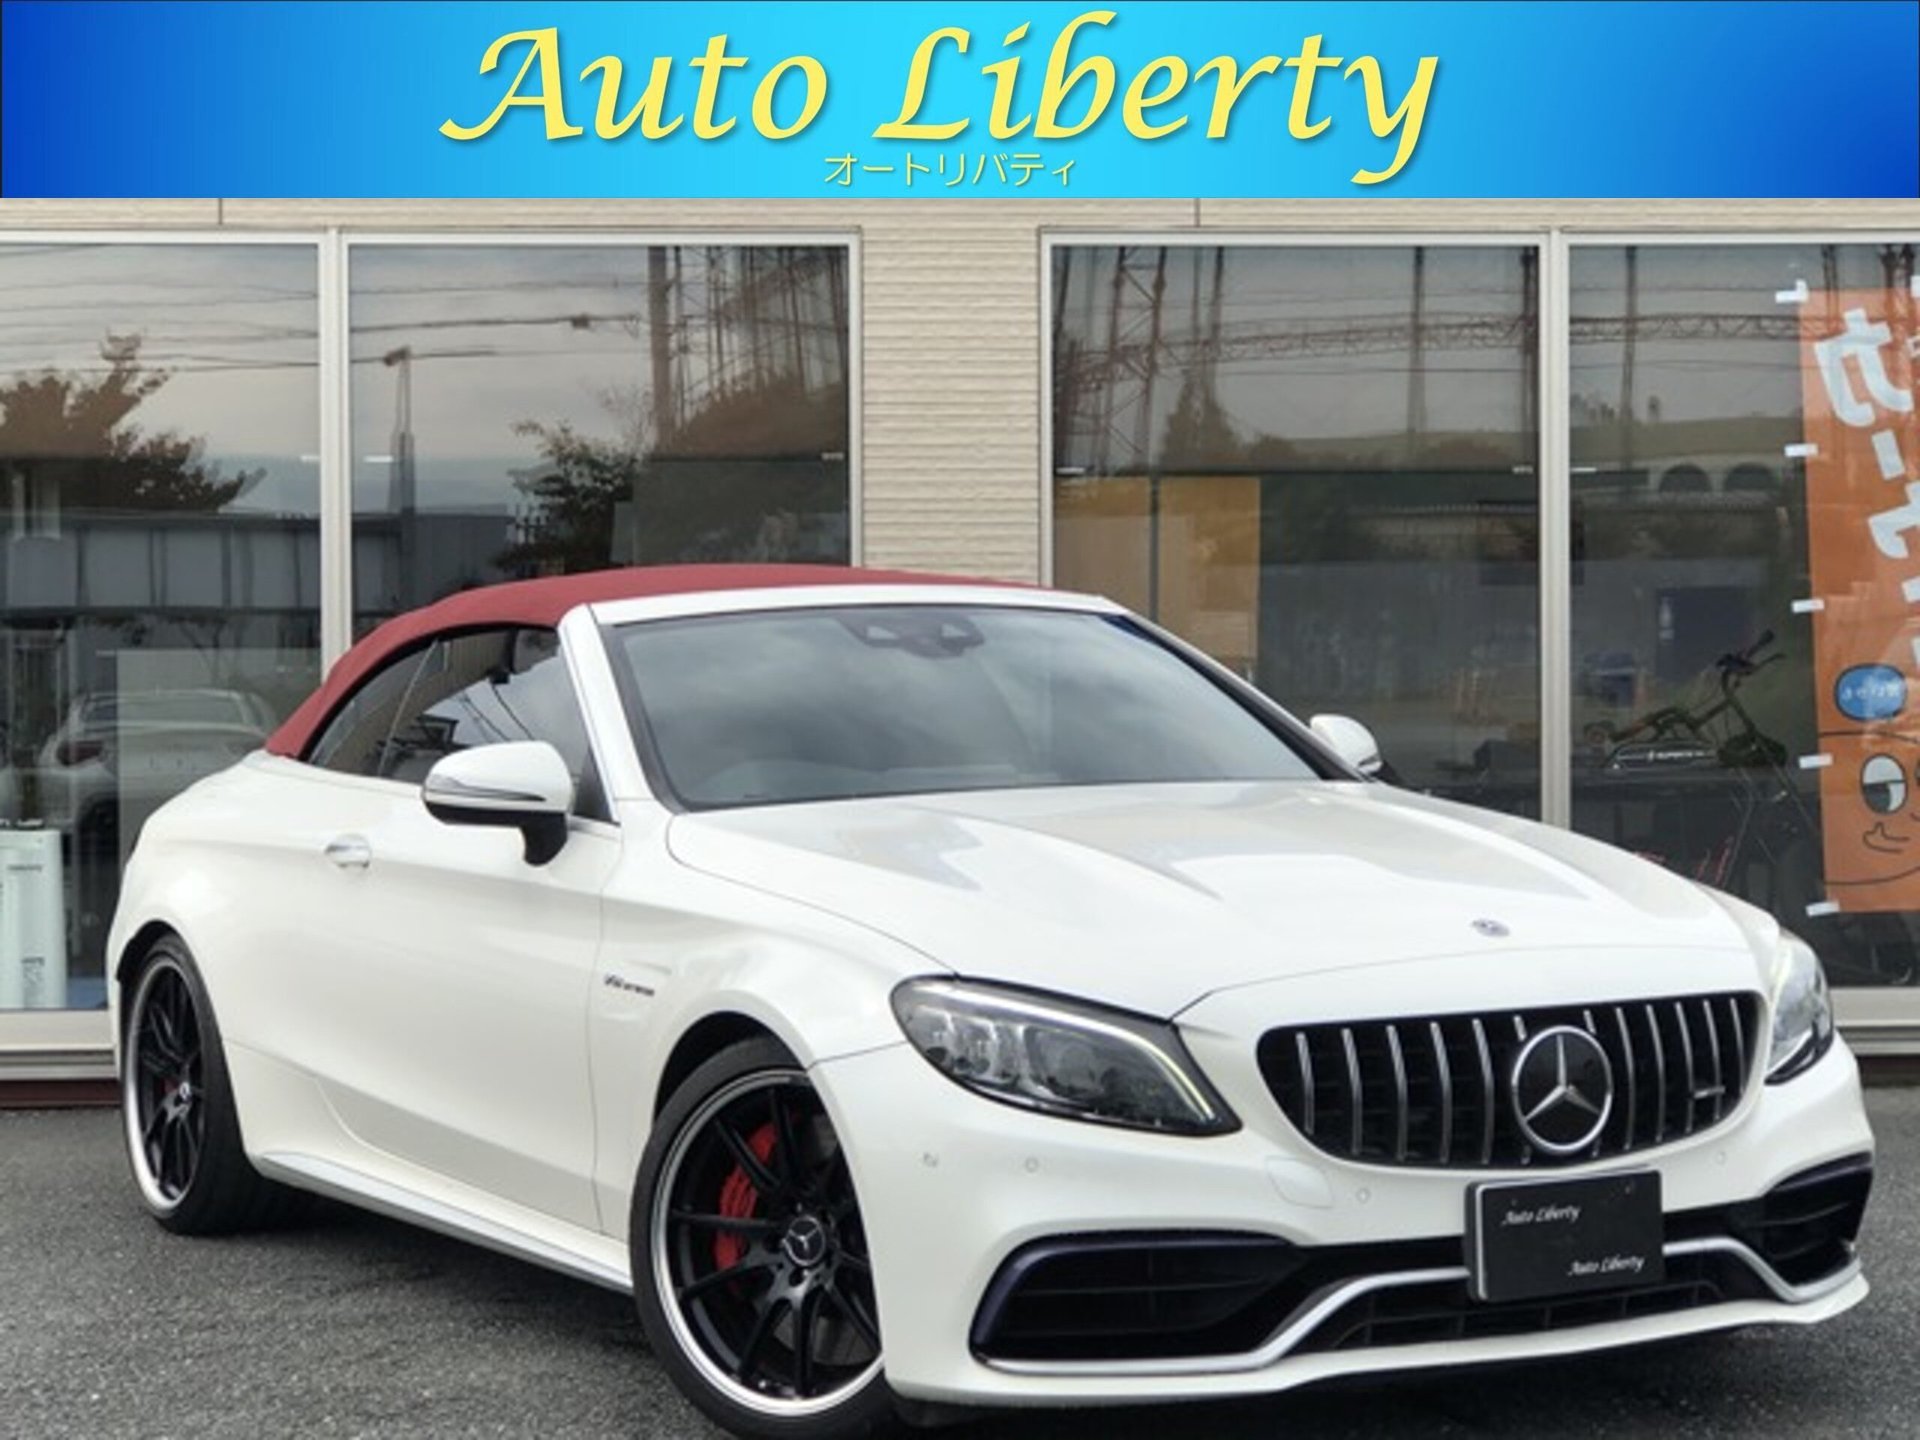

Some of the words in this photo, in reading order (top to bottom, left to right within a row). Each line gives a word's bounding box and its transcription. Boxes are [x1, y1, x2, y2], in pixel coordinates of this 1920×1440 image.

[1502, 1209, 1534, 1226] Auto
[1536, 1204, 1580, 1223] Liberty
[1568, 1260, 1600, 1276] Auto
[1601, 1255, 1645, 1273] Liberty
